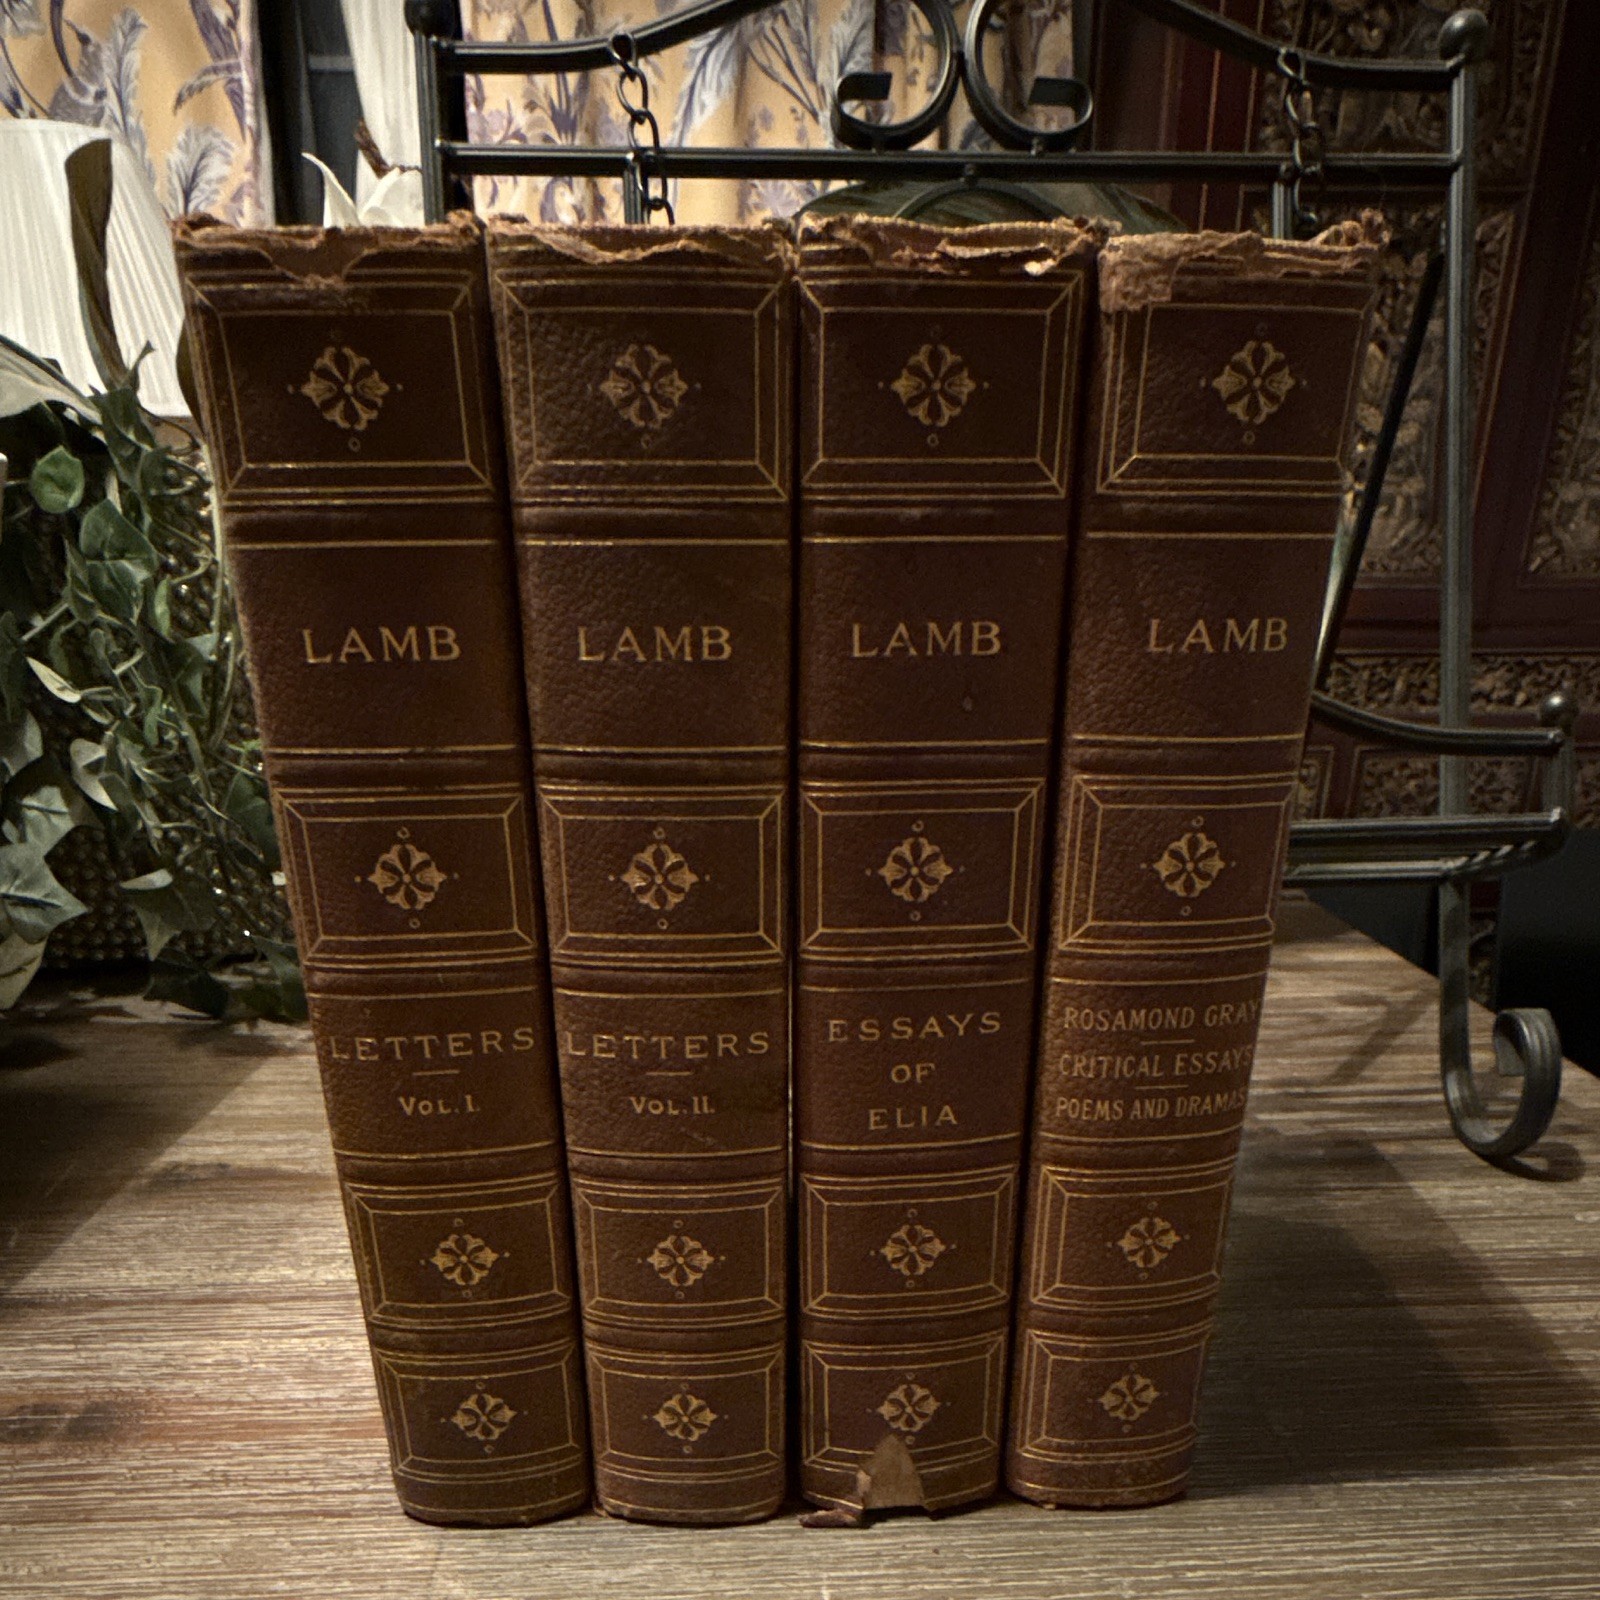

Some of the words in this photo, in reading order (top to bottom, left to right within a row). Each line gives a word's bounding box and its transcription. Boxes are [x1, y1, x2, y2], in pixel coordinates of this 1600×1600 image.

[302, 624, 462, 665] LAMB
[577, 624, 733, 663] LAMB
[850, 620, 1002, 659] LAMB
[1146, 617, 1289, 655] LAMB
[827, 1011, 1001, 1042] ESSAYS
[1063, 1006, 1195, 1032] ROSAMOND
[1204, 1002, 1259, 1028] GRAY
[329, 1027, 536, 1061] LETTERS
[563, 1030, 770, 1060] LETTERS
[890, 1062, 936, 1084] OF
[1058, 1053, 1164, 1079] CRITICAL
[867, 1104, 959, 1131] ELIA
[1054, 1096, 1124, 1121] POEMS
[1130, 1098, 1170, 1120] AND
